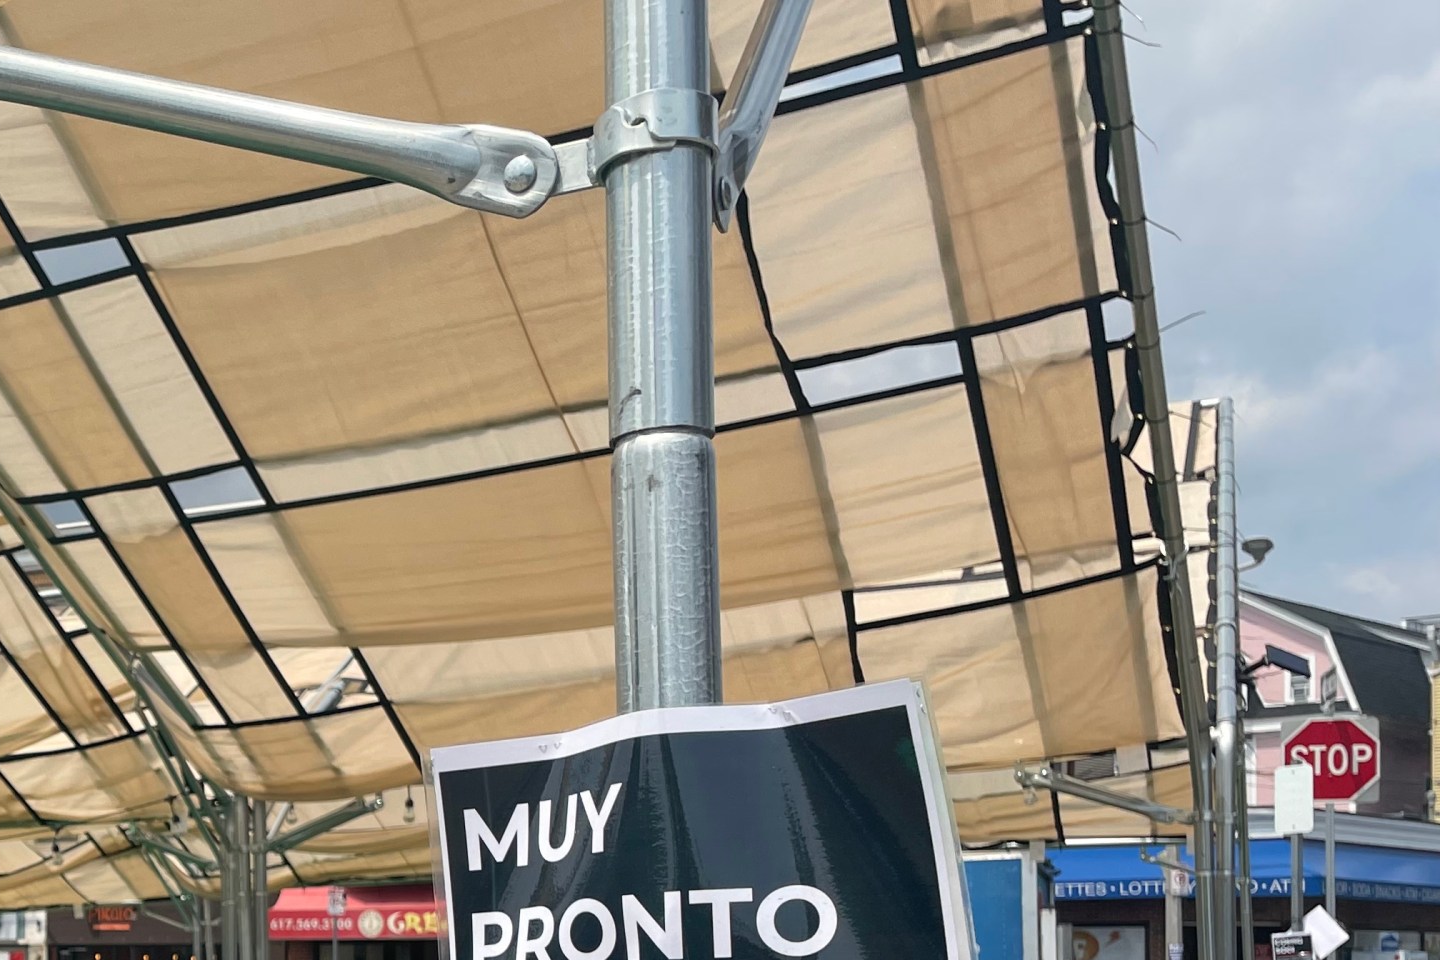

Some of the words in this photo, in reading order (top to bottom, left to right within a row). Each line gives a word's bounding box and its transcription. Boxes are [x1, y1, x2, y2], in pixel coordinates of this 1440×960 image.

[1291, 743, 1372, 776] STOP
[463, 783, 622, 871] MUY
[1120, 880, 1196, 896] LOTTY
